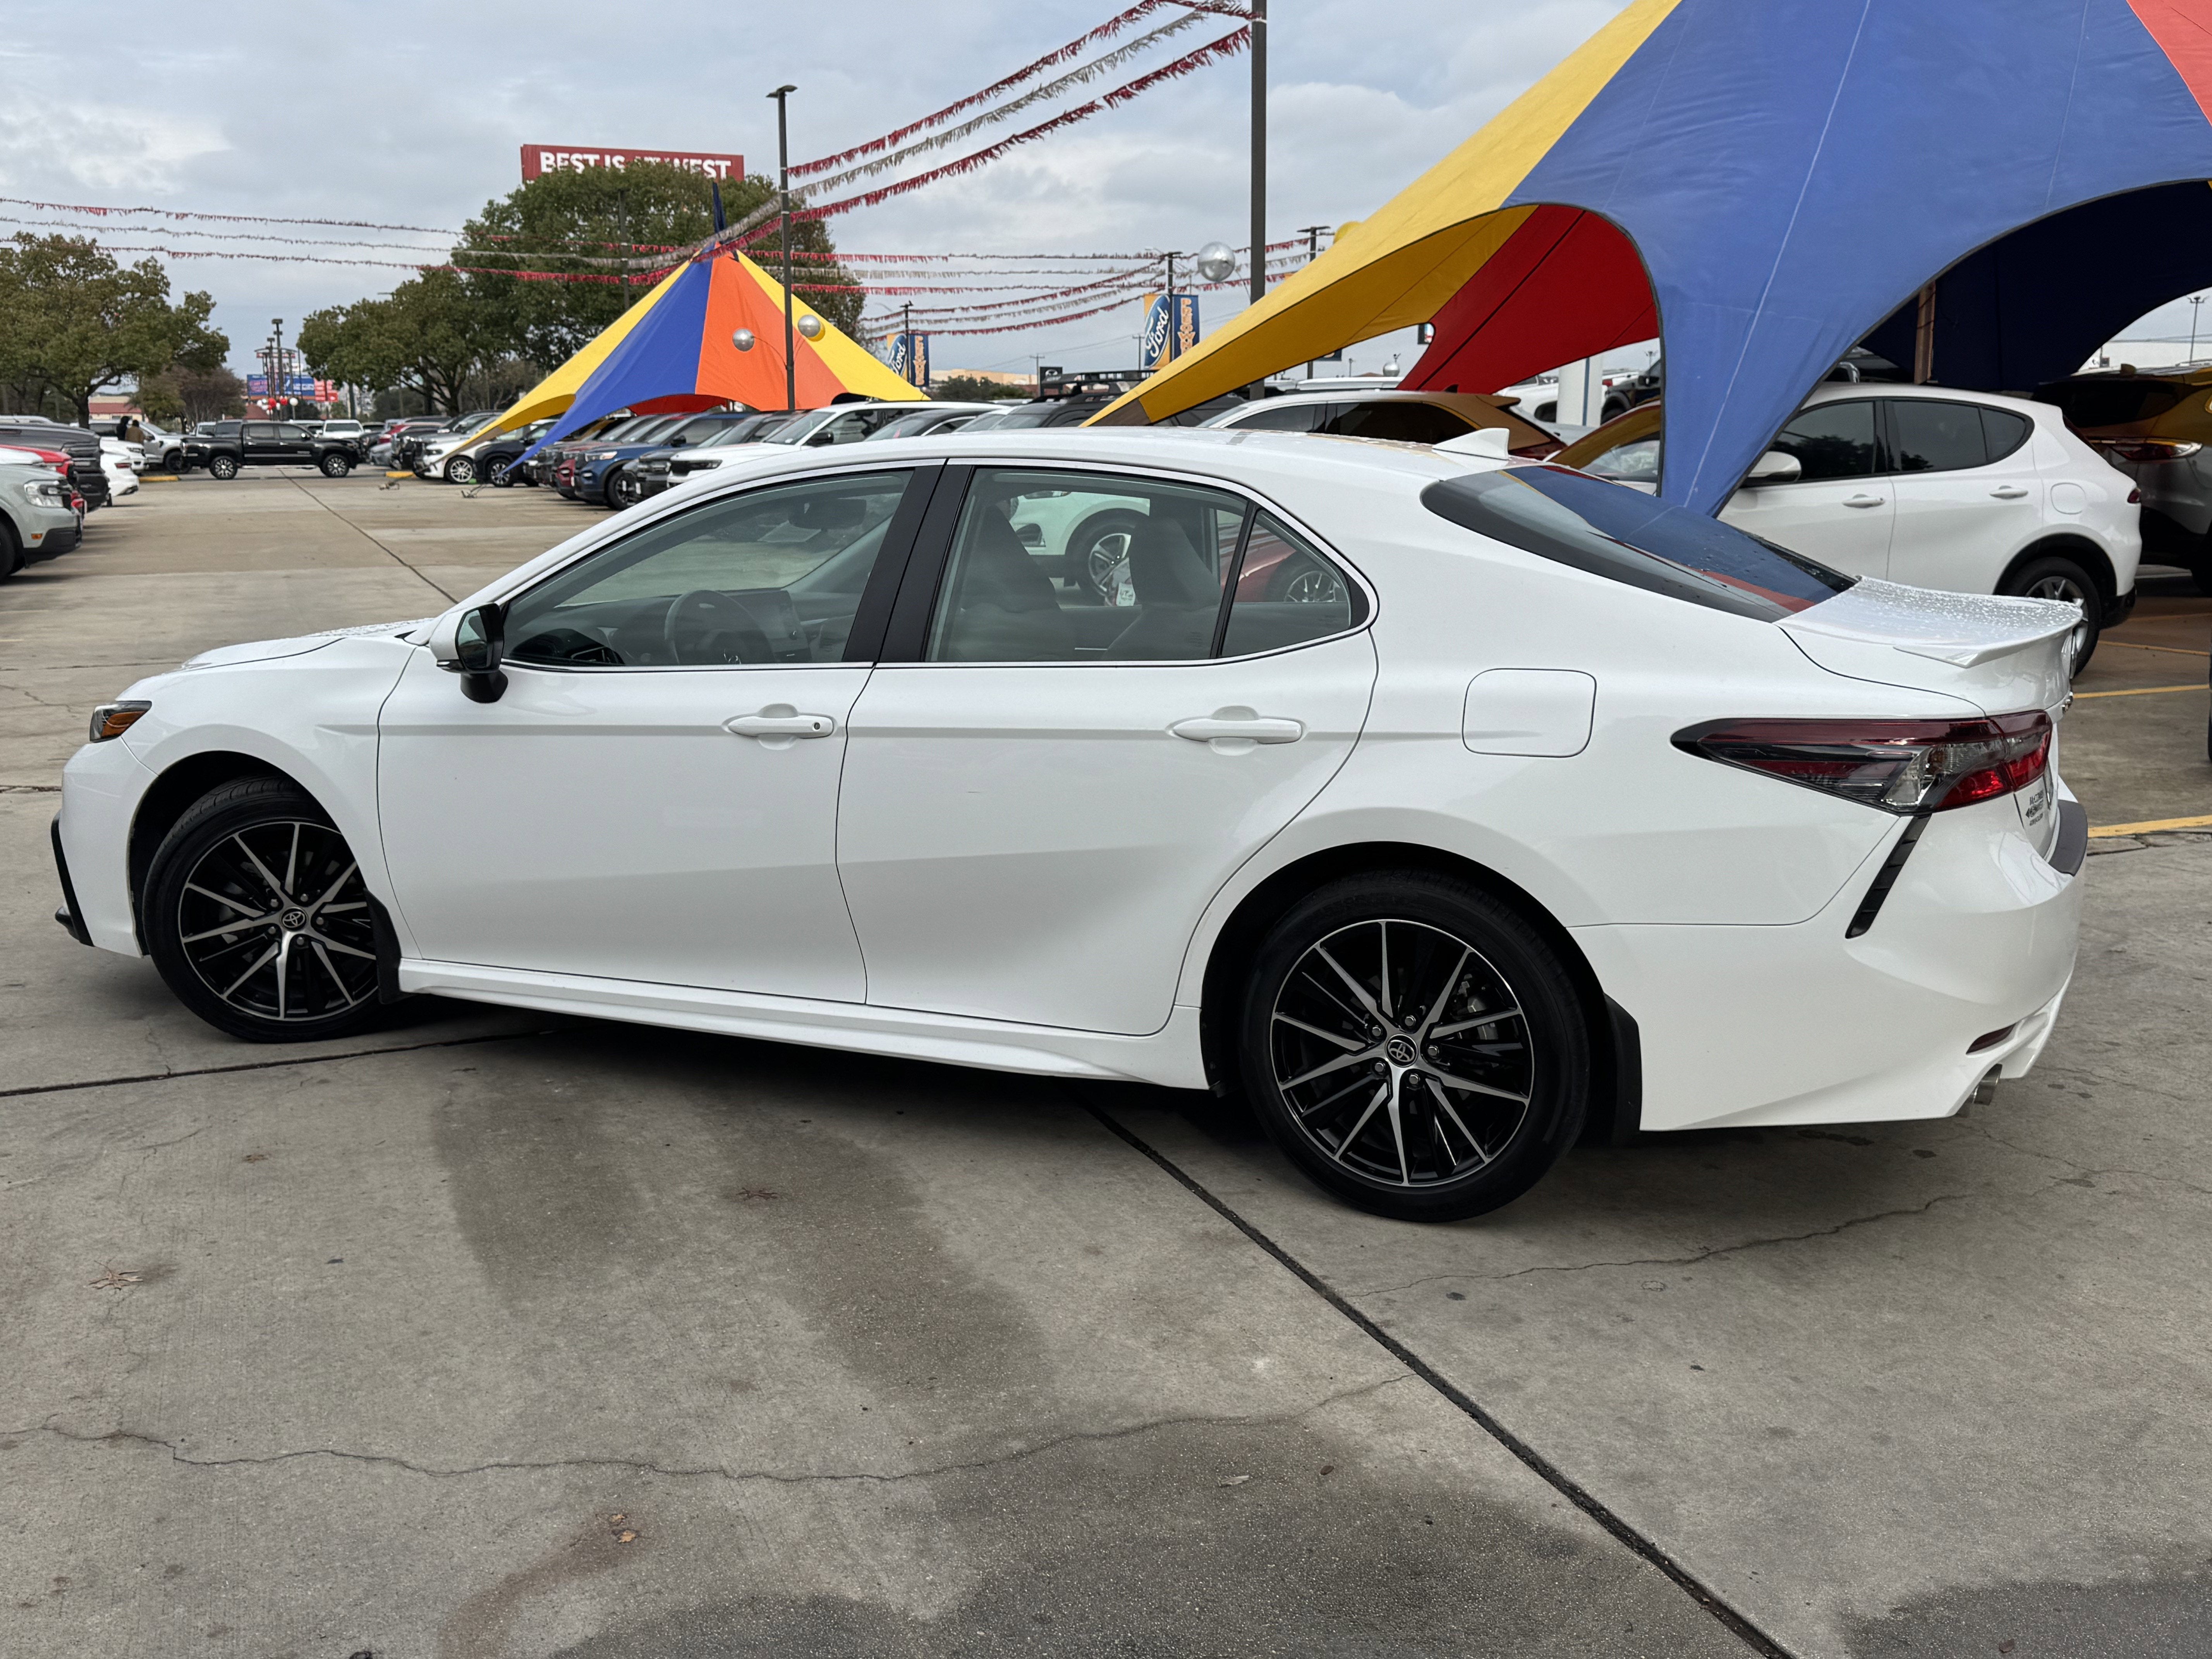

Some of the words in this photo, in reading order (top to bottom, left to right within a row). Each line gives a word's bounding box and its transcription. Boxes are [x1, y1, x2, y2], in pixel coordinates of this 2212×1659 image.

[540, 151, 600, 174] BEST
[1145, 306, 1169, 357] Ford
[888, 342, 906, 375] Ford
